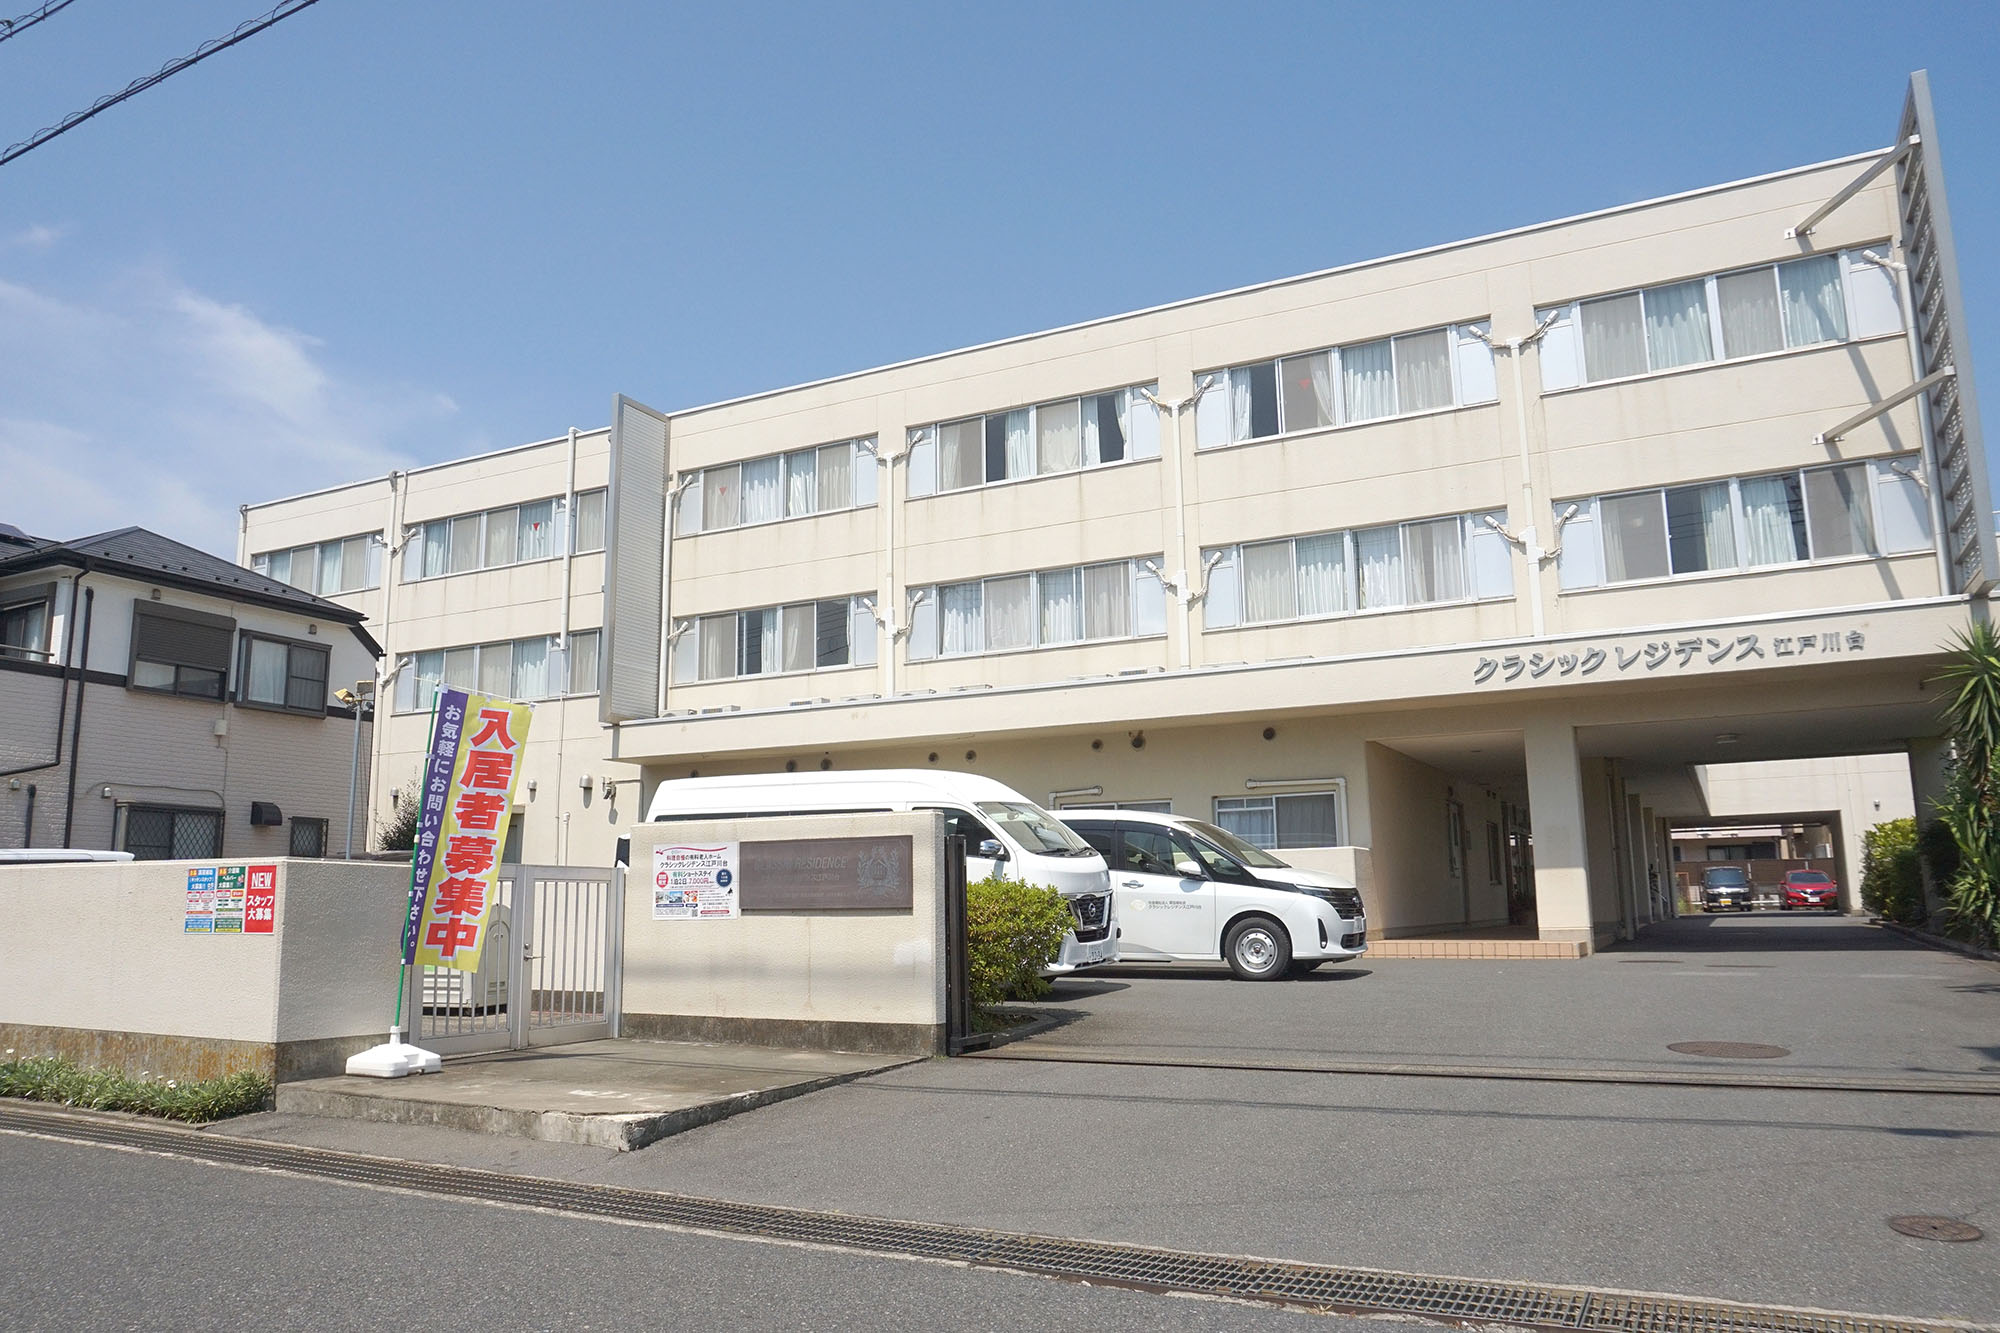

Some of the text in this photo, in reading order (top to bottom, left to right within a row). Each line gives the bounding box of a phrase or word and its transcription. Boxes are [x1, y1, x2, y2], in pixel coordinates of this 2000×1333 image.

[423, 707, 520, 961] 入居者募集中
[251, 872, 273, 887] NEW
[247, 895, 274, 907] スタッフ
[247, 908, 272, 921] 大募集
